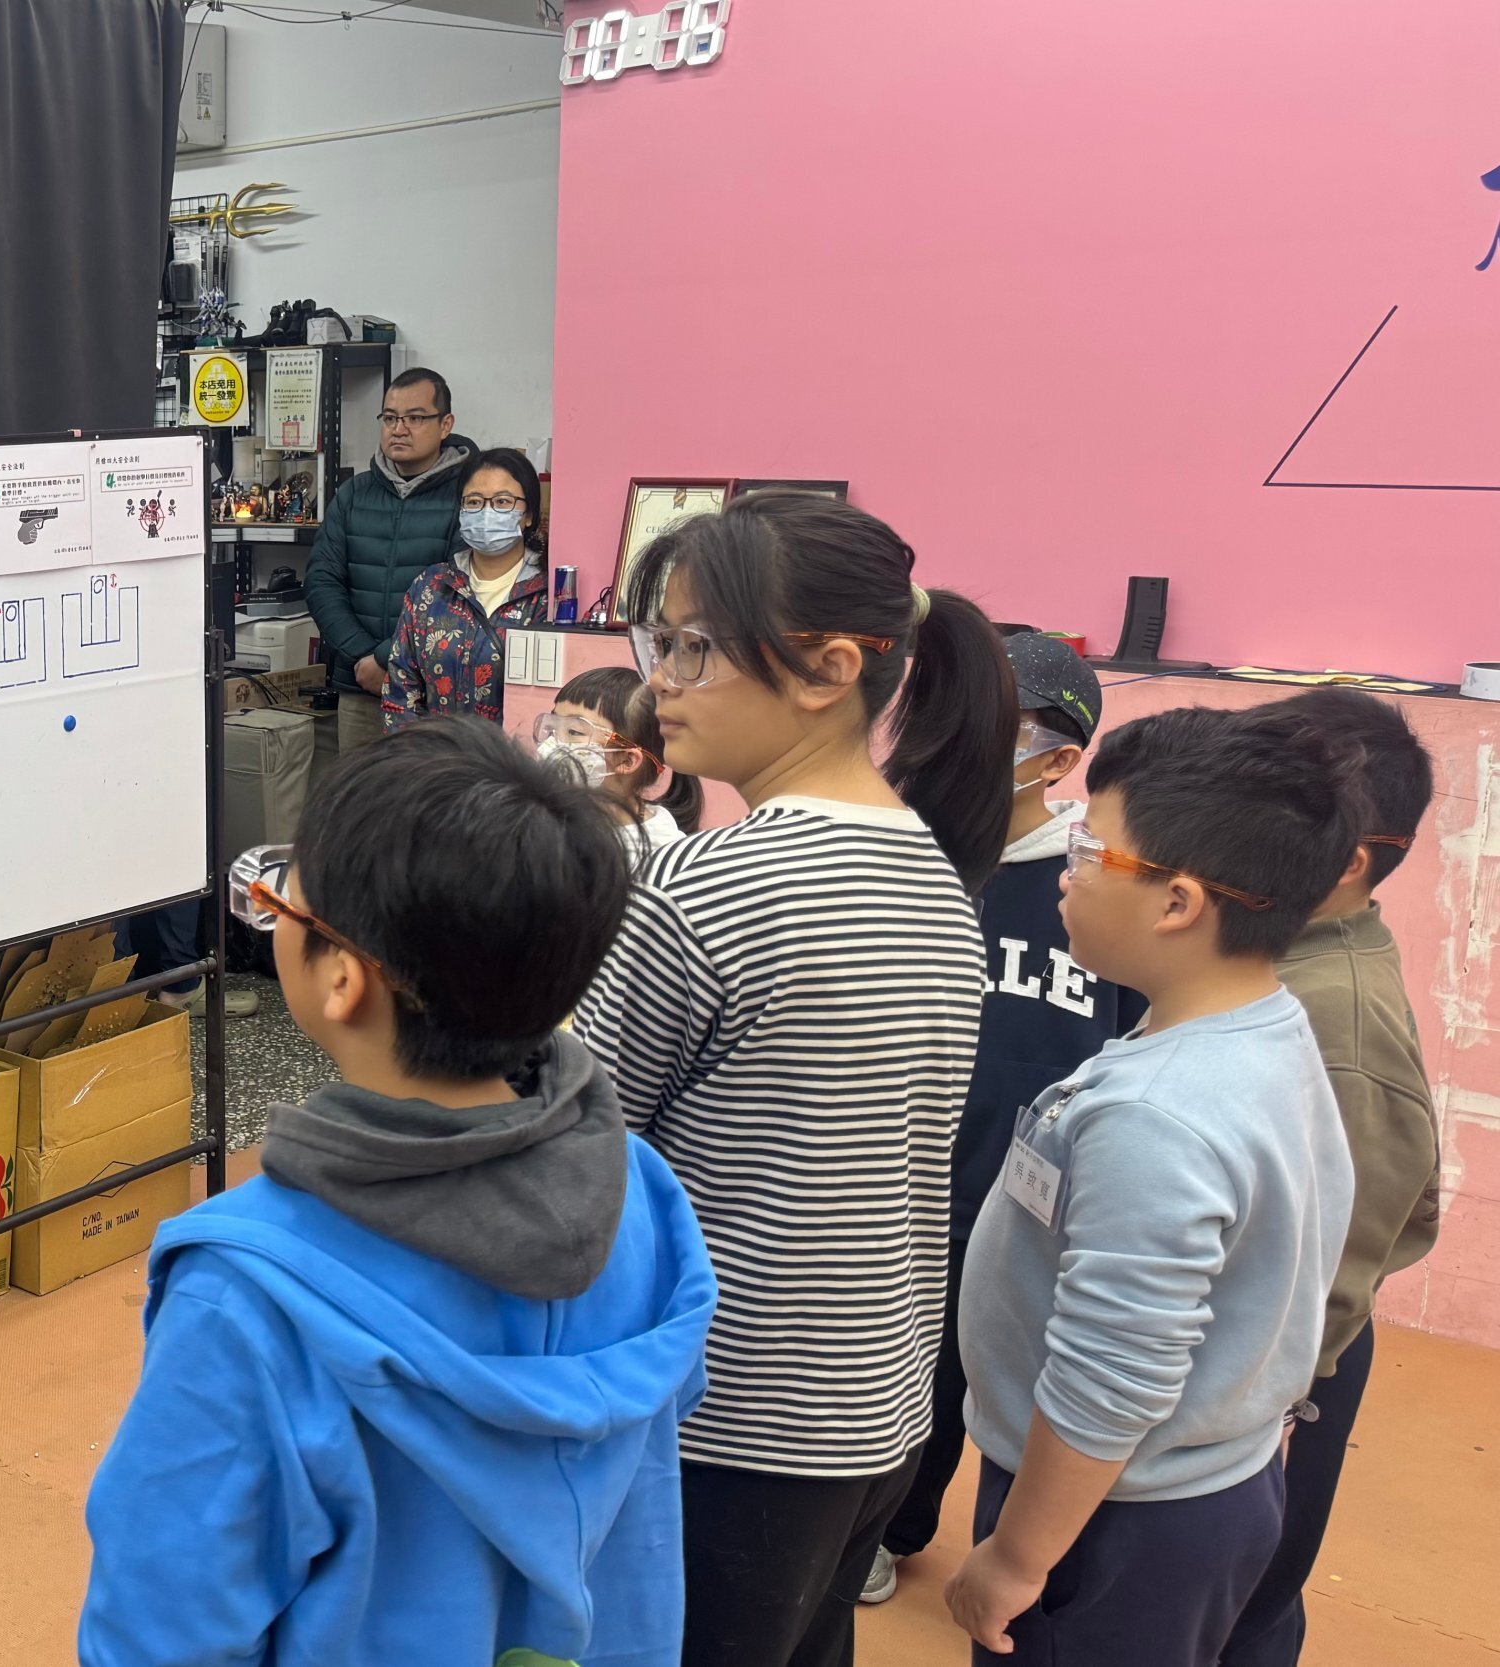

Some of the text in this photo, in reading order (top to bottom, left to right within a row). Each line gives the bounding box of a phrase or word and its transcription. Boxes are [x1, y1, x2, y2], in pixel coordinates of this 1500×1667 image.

[198, 379, 236, 390] 本店免用
[198, 390, 237, 401] 統一發票
[984, 937, 1098, 1019] LE
[82, 1211, 103, 1227] C/NO.
[82, 1207, 140, 1240] MADE IN TAIWAN
